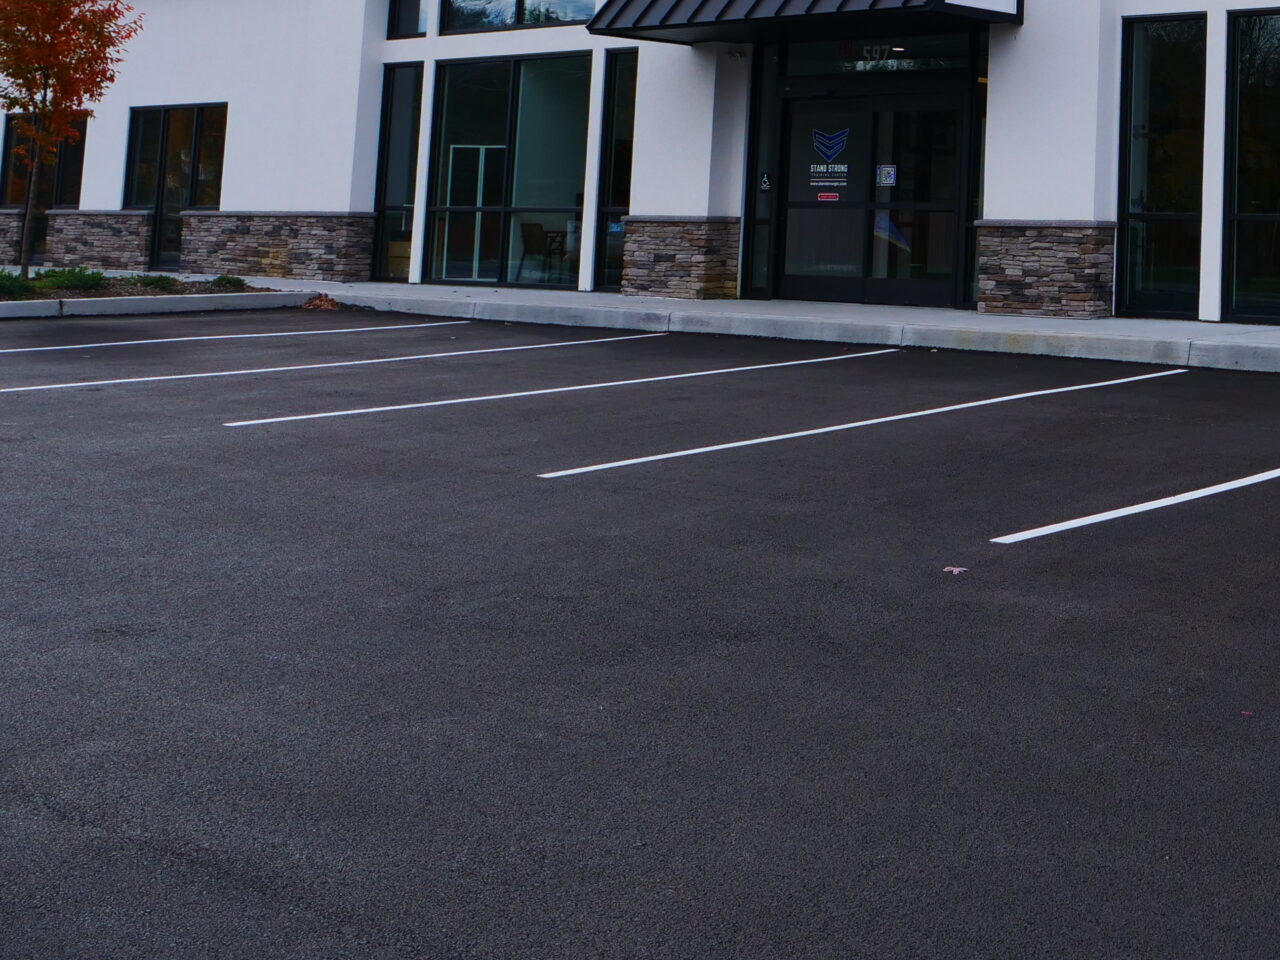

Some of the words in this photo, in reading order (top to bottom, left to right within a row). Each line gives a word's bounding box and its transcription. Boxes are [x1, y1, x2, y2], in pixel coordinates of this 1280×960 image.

[863, 44, 890, 61] 597
[810, 164, 827, 172] STAND
[828, 164, 848, 172] STRONG
